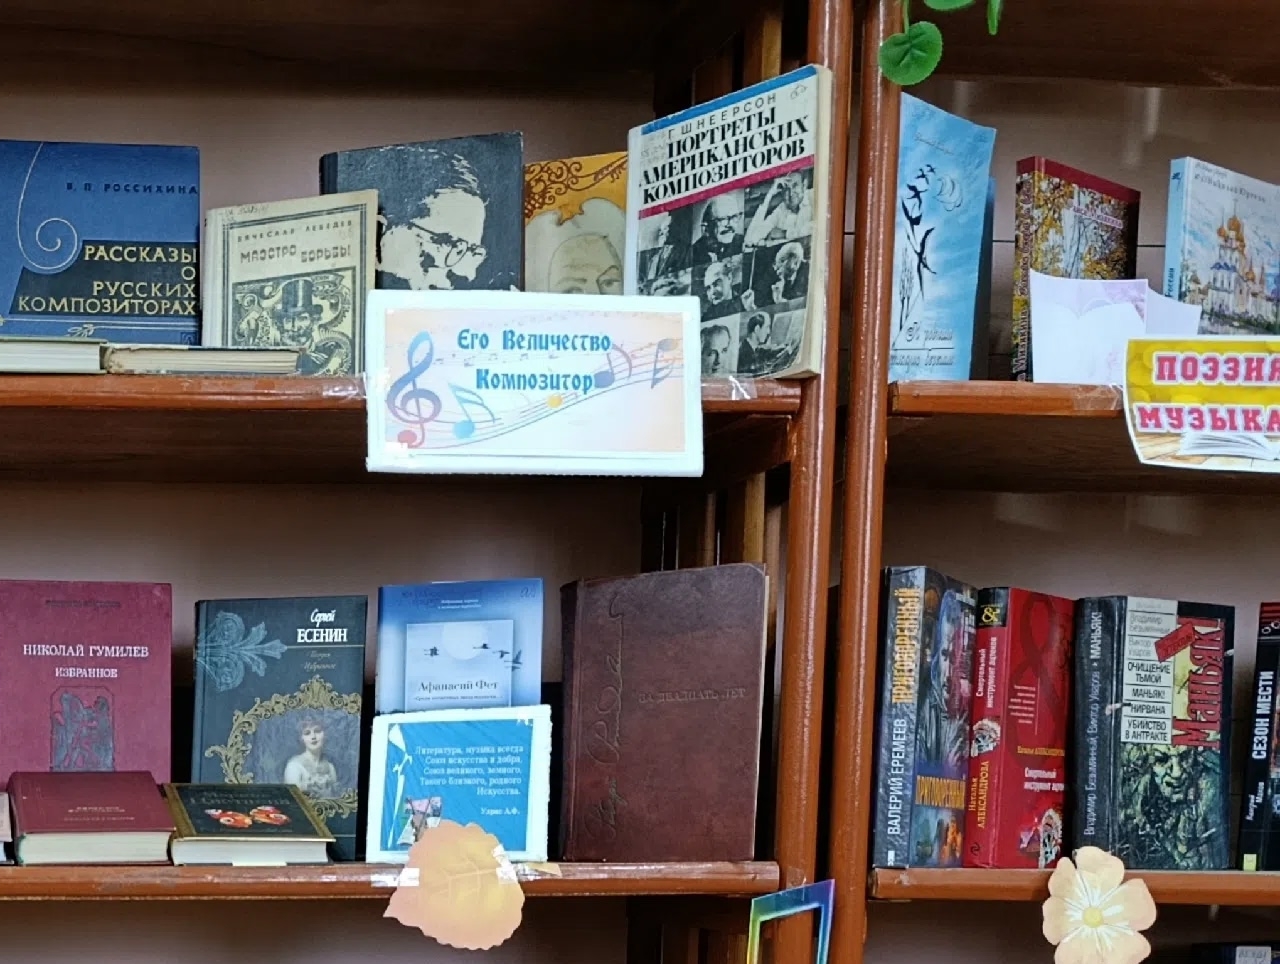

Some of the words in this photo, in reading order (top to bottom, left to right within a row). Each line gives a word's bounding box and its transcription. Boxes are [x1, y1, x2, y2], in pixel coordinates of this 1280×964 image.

[681, 92, 777, 136] ШНЕЕРСОН
[668, 106, 776, 158] ПОРТРЕТЫ
[639, 115, 809, 187] АМЕРИКАНСКИХ
[643, 138, 805, 205] КОМПОЗИТОРОВ
[104, 183, 198, 195] РОССИХИНА
[83, 244, 197, 264] РАССКАЗЫ
[181, 266, 196, 281] О
[93, 281, 196, 298] РУССКИХ
[18, 296, 197, 316] КОМПОЗИТОРАХ
[457, 327, 490, 352] Его
[501, 327, 611, 354] Величество
[475, 366, 594, 397] Композитор
[297, 628, 348, 643] ЕСЕНИН
[891, 588, 920, 704] ПРИГОВОРЕННЫЙ
[1089, 611, 1103, 656] МАНЬЯК!
[23, 643, 85, 658] НИКОЛАЙ
[89, 645, 150, 659] ГУМИЛЕВ
[55, 667, 118, 679] ИЗБРАННОЕ
[976, 648, 986, 697] Смертельный
[1128, 662, 1170, 673] ОЧИЩЕНИЕ
[1136, 674, 1161, 684] ТЬМОЙ
[418, 681, 473, 694] Афанасий
[475, 679, 499, 691] Фет
[1089, 671, 1102, 701] Уваров
[1132, 688, 1165, 699] МАНЬЯК!
[1256, 671, 1274, 715] МЕСТИ
[1087, 703, 1099, 734] Виктор
[1131, 704, 1165, 714] НИРВАНА
[1125, 731, 1130, 740] В
[1131, 731, 1167, 742] АНТРАКТЕ
[1128, 719, 1166, 731] УБИЙСТВО
[1251, 718, 1270, 760] СЕЗОН
[890, 718, 906, 775] ЕРЕМЕЕВ
[887, 777, 904, 836] ВАЛЕРИЙ
[968, 778, 978, 811] Наталья
[977, 761, 989, 829] АЛЕКСАНДРОВА
[1083, 793, 1096, 836] Владимир
